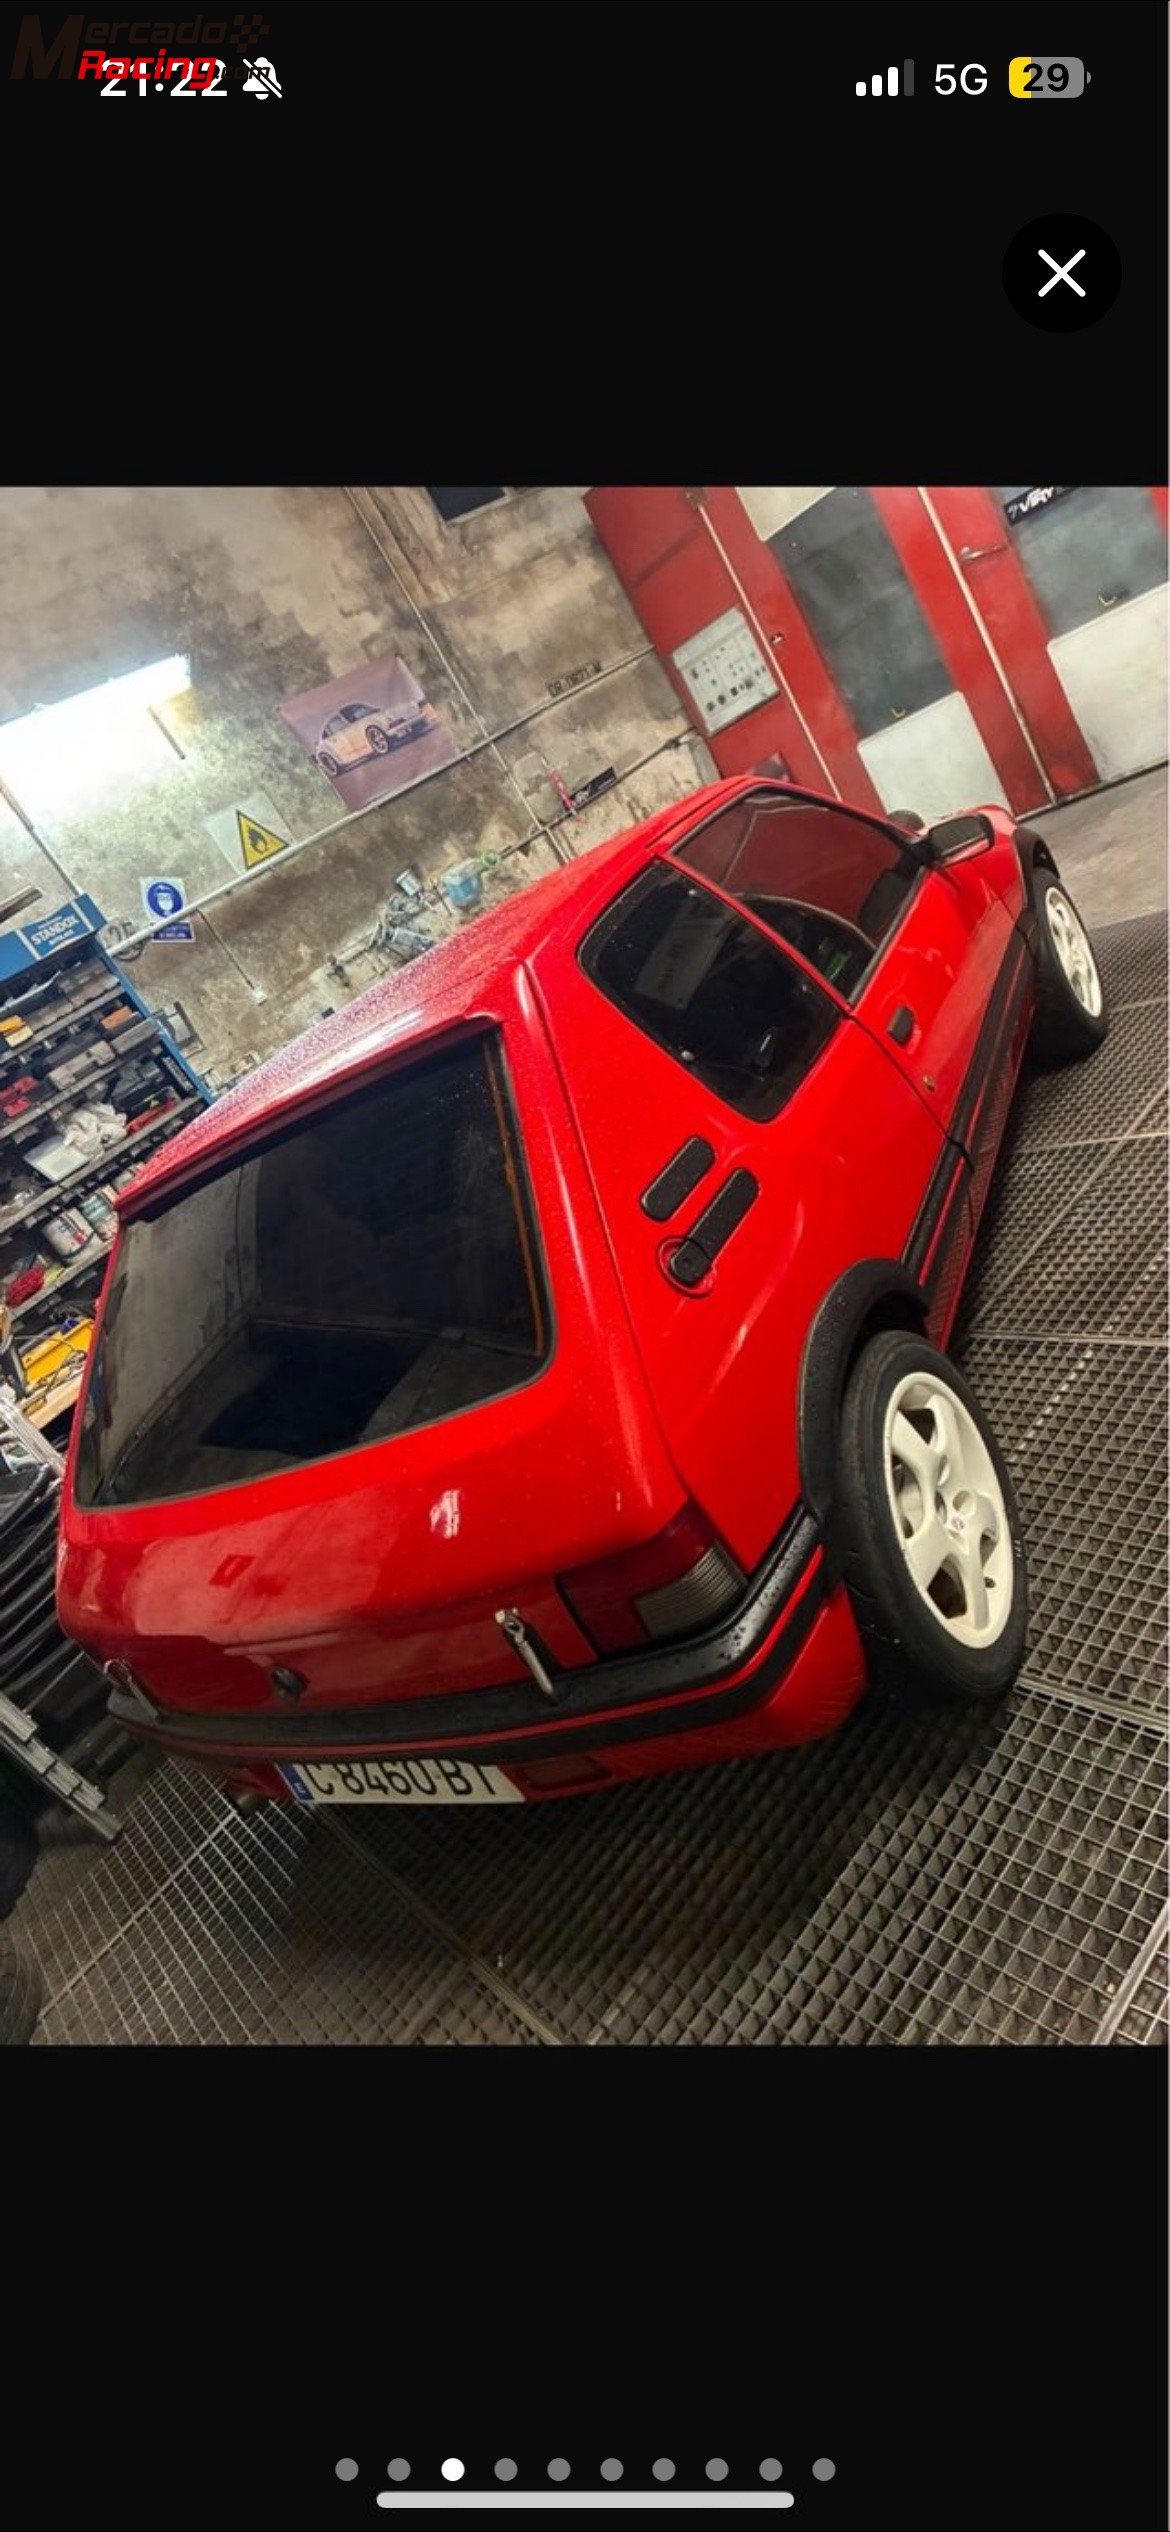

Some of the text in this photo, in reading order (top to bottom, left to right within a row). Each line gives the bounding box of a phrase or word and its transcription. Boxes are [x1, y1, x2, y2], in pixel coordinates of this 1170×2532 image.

[935, 63, 988, 95] 5G
[1022, 63, 1070, 92] 29
[302, 1762, 334, 1796] C
[336, 1760, 438, 1796] 8460
